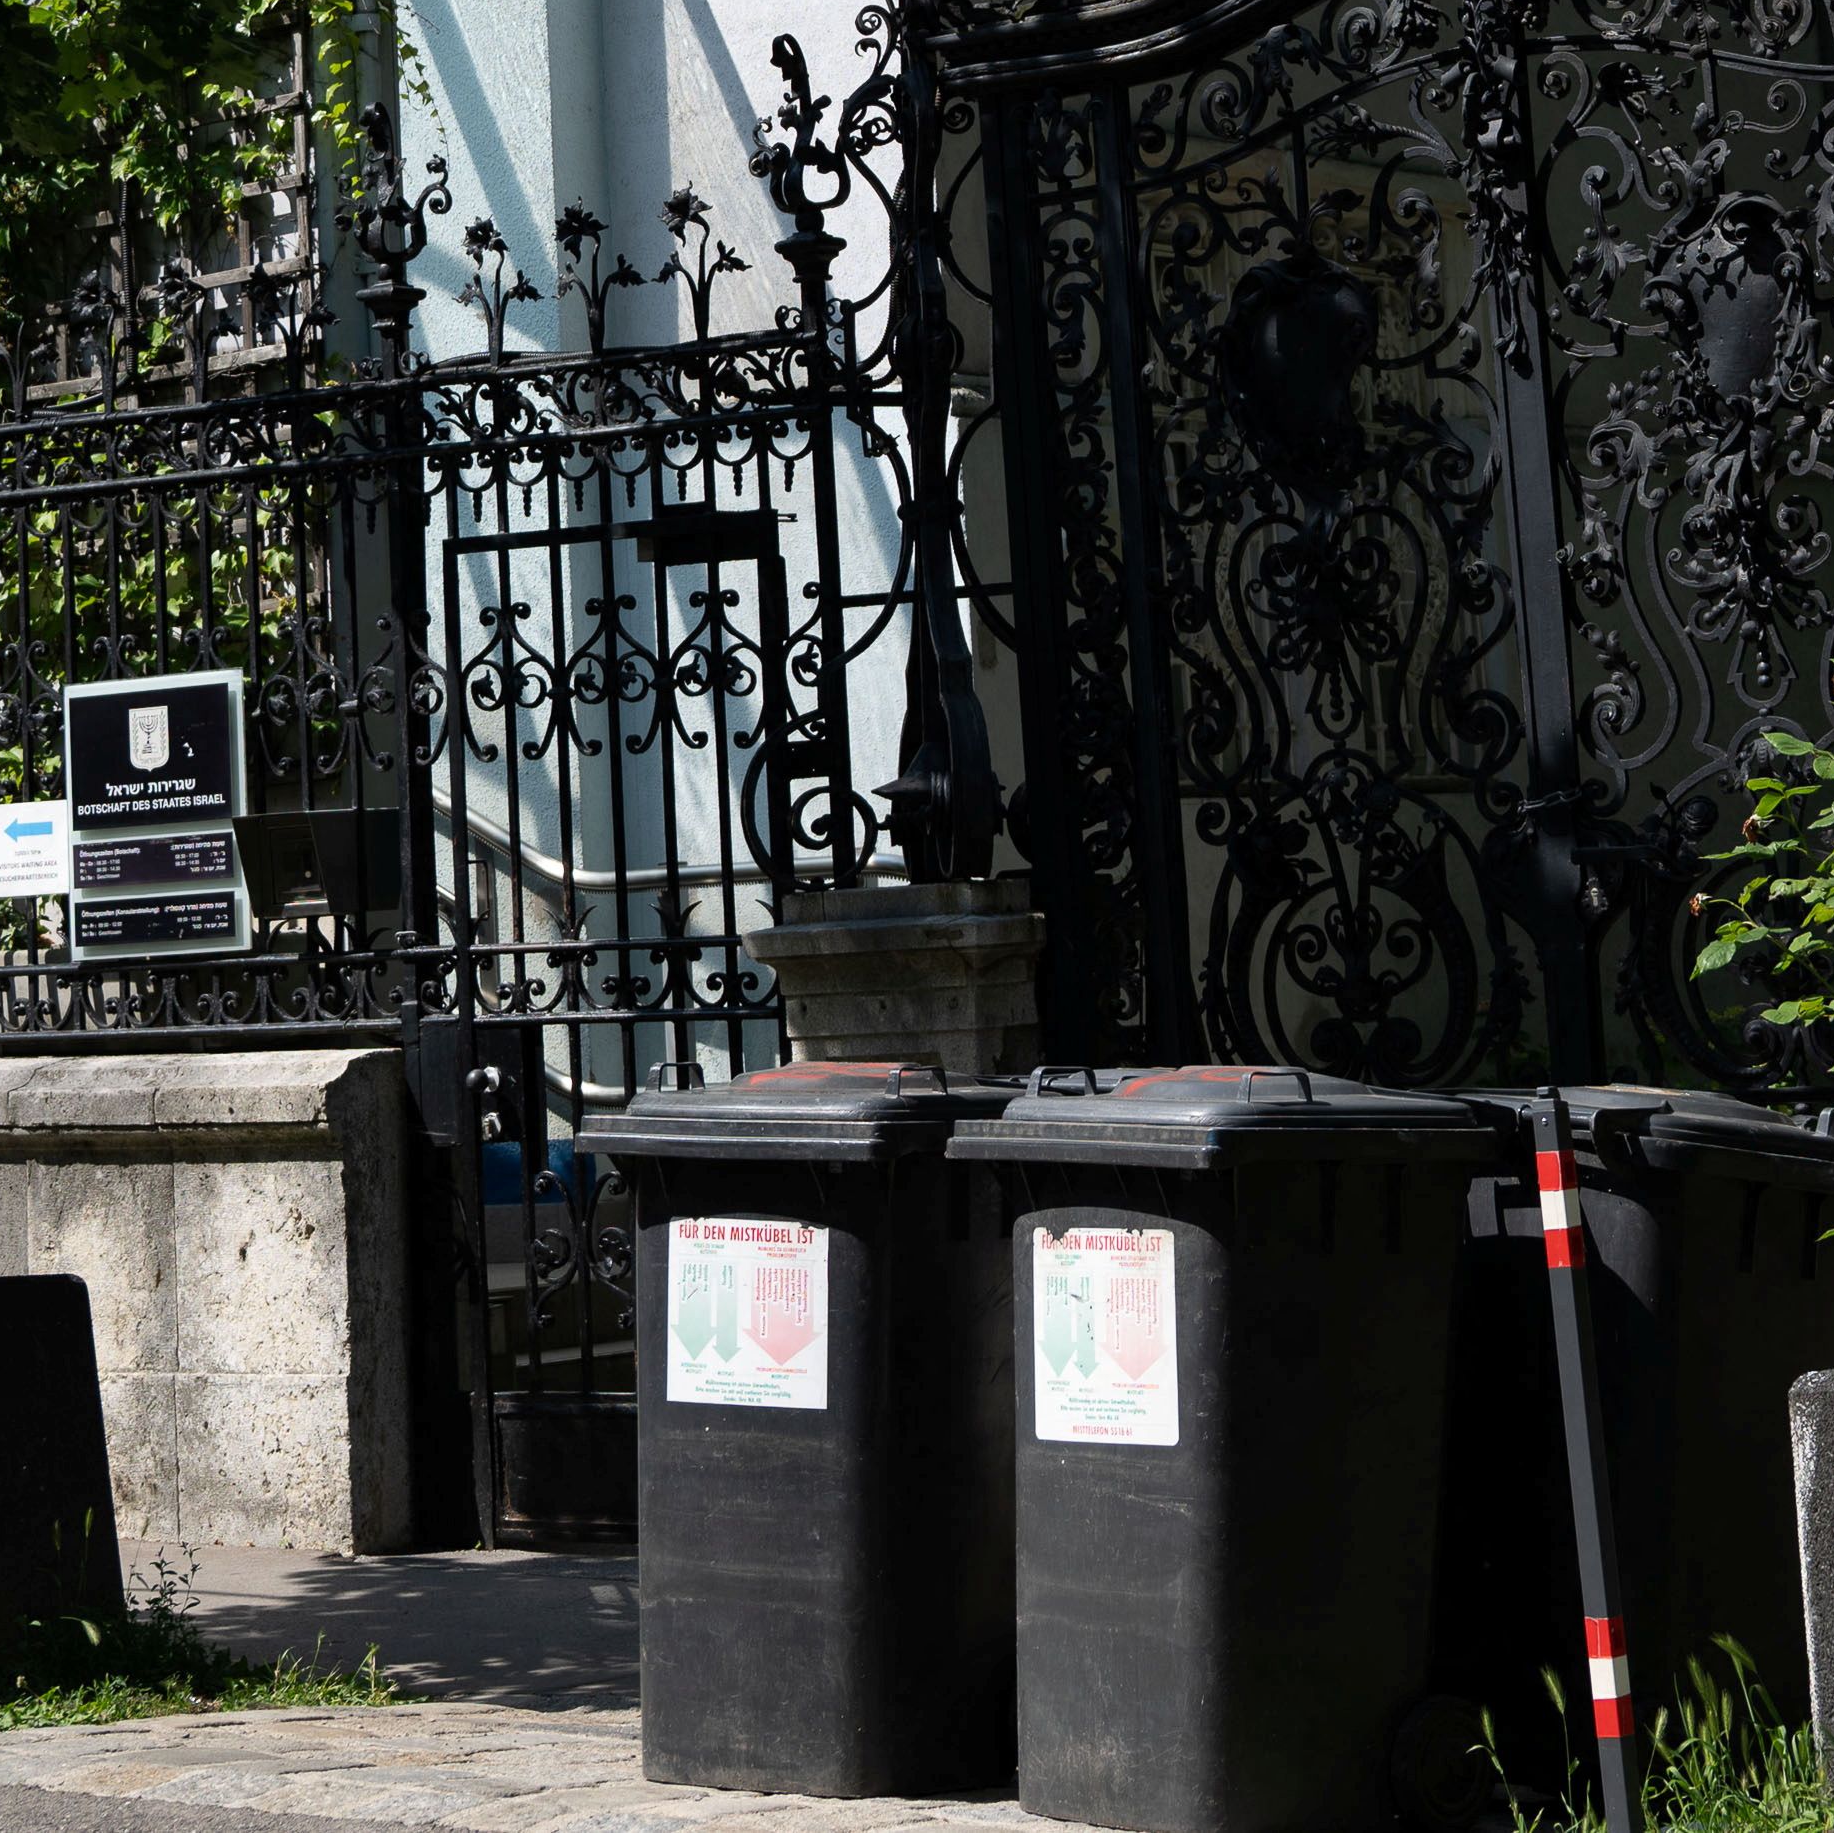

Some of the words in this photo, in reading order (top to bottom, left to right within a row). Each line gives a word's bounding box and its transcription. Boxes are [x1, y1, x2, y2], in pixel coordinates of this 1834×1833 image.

[105, 783, 144, 797] ישראל
[148, 778, 196, 793] שגרירות
[77, 801, 130, 815] BOTSCHAFT
[132, 800, 151, 811] DES
[152, 796, 192, 810] STAATES
[193, 793, 226, 806] ISRAEL
[679, 1221, 699, 1239] FÜR
[703, 1225, 725, 1241] DEN
[730, 1224, 793, 1244] MISTKÜBEL
[797, 1229, 815, 1245] IST
[1085, 1232, 1142, 1252] MISTKÜBEL
[1072, 1425, 1109, 1436] MISTTELEFON
